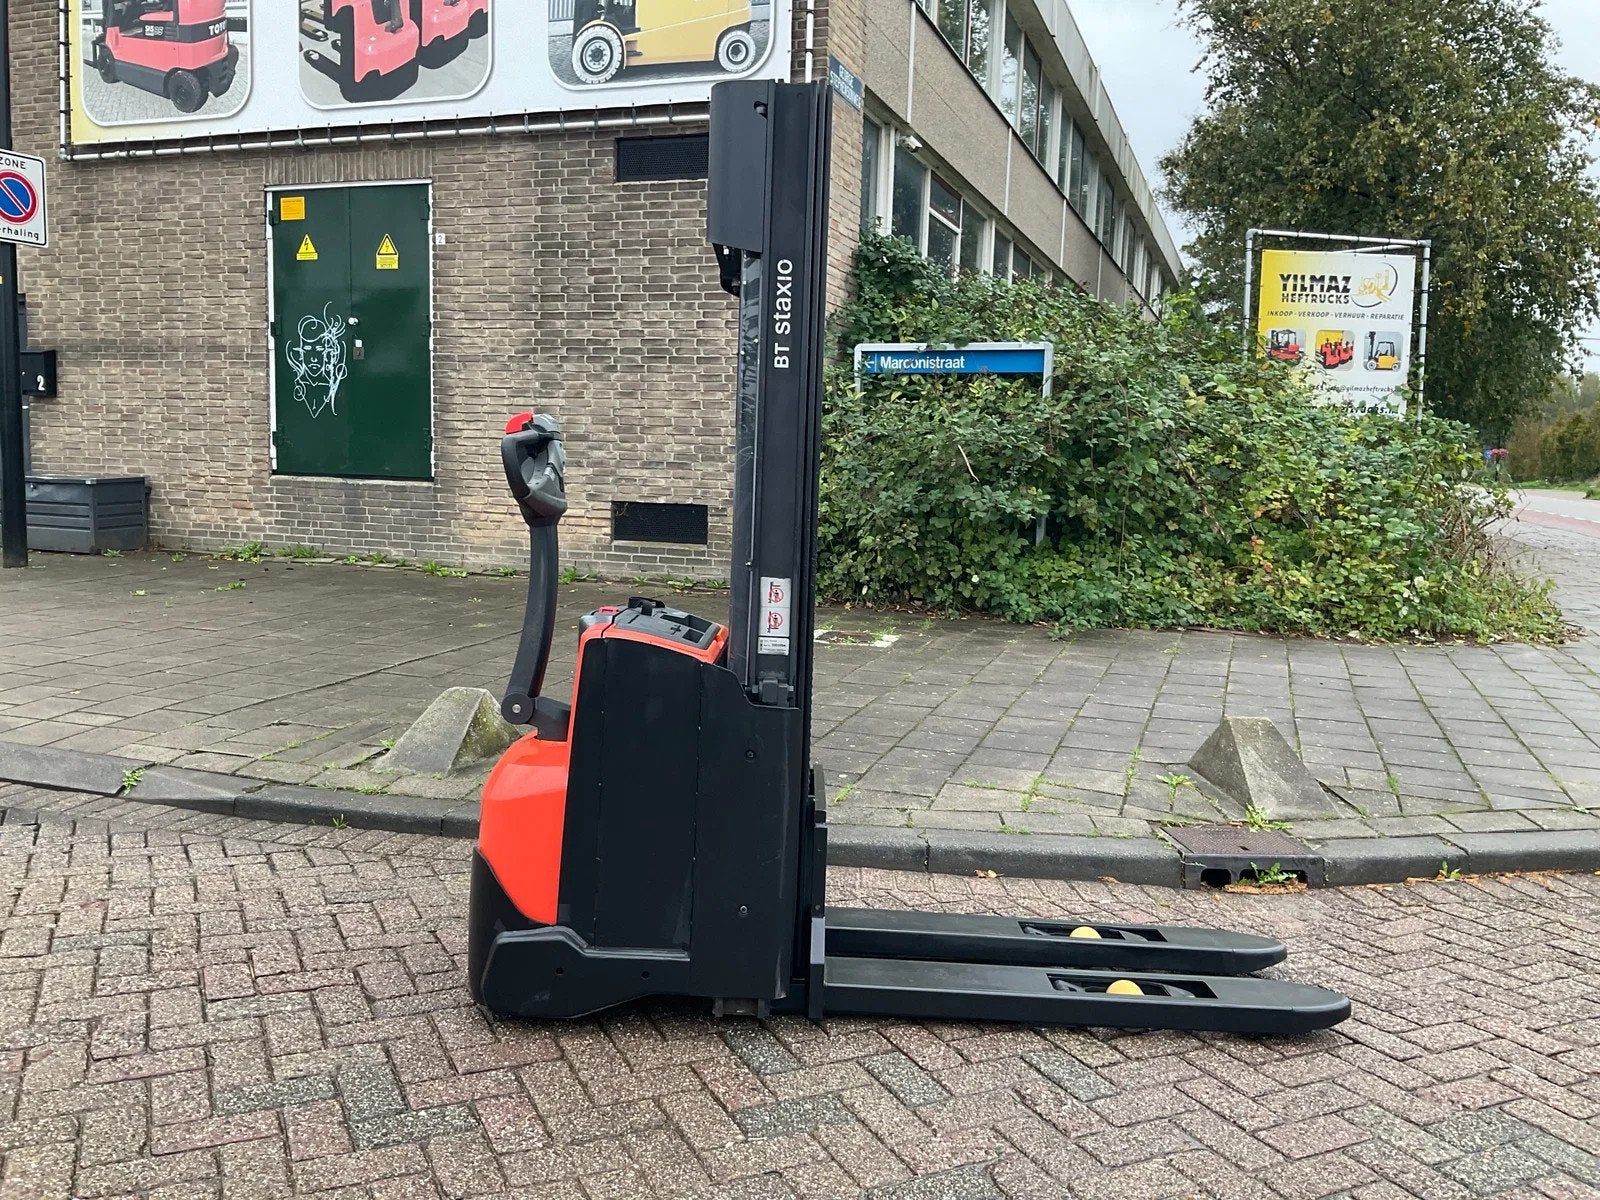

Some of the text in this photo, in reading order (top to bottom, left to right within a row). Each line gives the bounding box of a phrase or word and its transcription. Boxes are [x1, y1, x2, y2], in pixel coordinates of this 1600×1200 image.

[0, 226, 39, 240] rhaling
[1279, 273, 1352, 294] YILMAZ
[1281, 292, 1350, 305] HEFTRUCKS
[1334, 312, 1367, 320] VERHUUR
[1369, 313, 1405, 321] REPARATIE
[773, 342, 790, 369] BT
[880, 355, 965, 369] Marconistraat
[36, 374, 46, 391] 2
